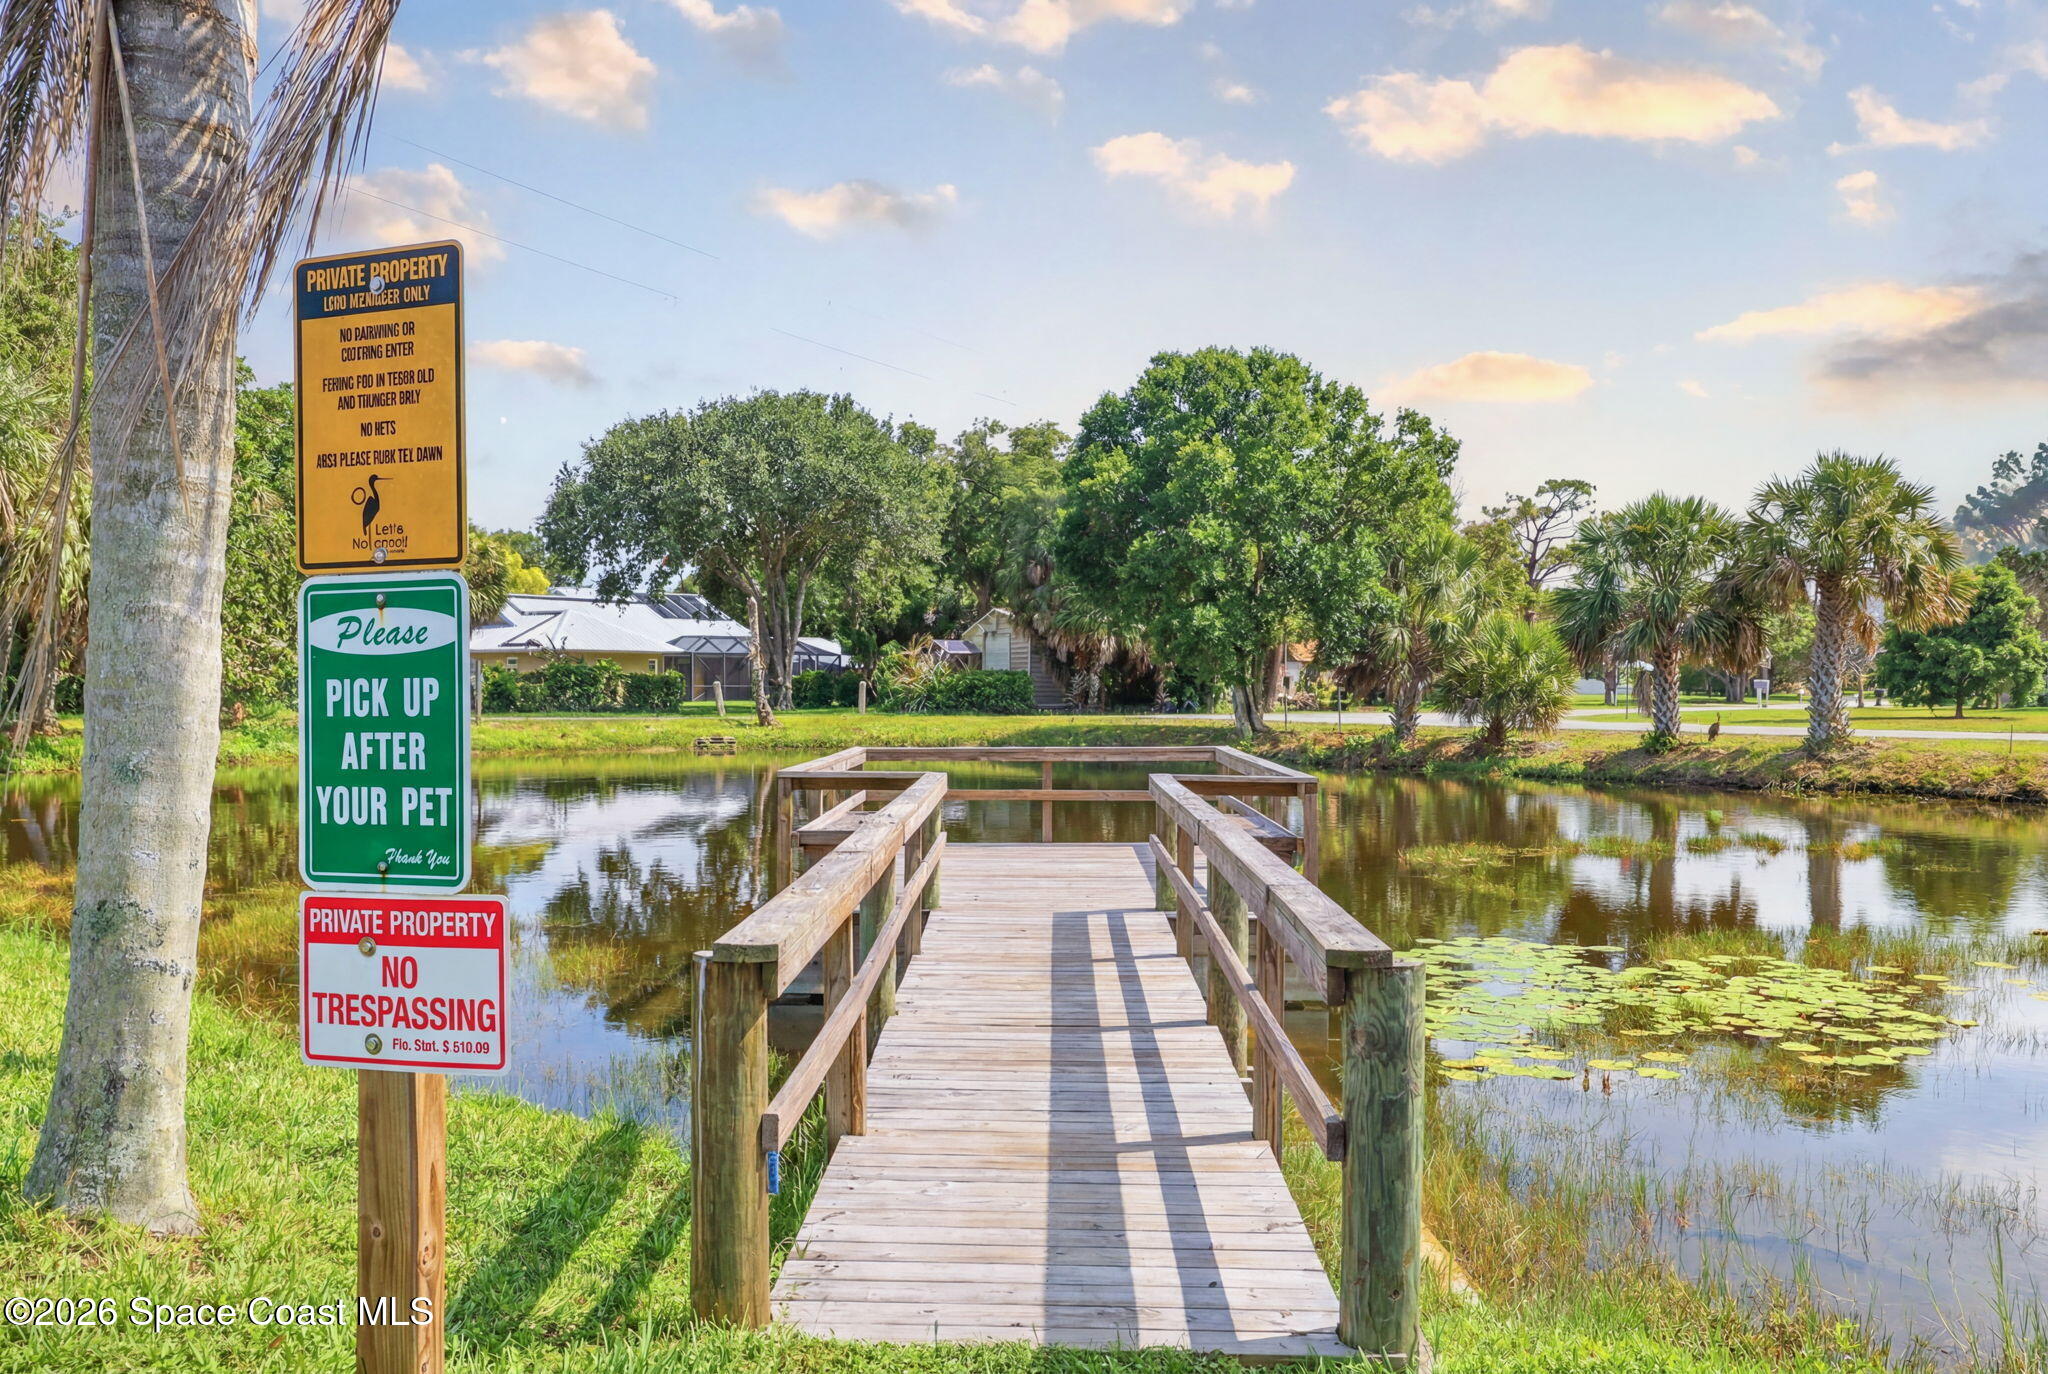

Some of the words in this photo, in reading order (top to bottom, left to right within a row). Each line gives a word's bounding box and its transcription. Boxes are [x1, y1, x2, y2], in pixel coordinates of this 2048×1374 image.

[306, 264, 366, 292] PRIVATE
[370, 254, 448, 283] PROPERTY
[404, 285, 430, 302] ONLY
[340, 328, 352, 342] NO
[402, 321, 415, 335] OR
[386, 342, 414, 358] ENTER
[376, 373, 385, 387] IN
[417, 368, 434, 383] OLD
[338, 396, 355, 410] AND
[361, 422, 372, 436] NO
[340, 451, 371, 467] PLEASE
[417, 446, 443, 461] DAWN
[336, 616, 429, 648] Please
[326, 678, 390, 718] PICK
[403, 678, 440, 717] UP
[341, 732, 426, 770] AFTER
[316, 787, 387, 826] YOUR
[402, 787, 452, 826] PET
[385, 848, 423, 864] Thank
[426, 849, 450, 870] You
[309, 908, 383, 934] PRIVATE
[390, 911, 496, 938] PROPERTY
[382, 956, 418, 989] NO
[312, 992, 496, 1032] TRESPASSING
[453, 1041, 489, 1054] 510.09
